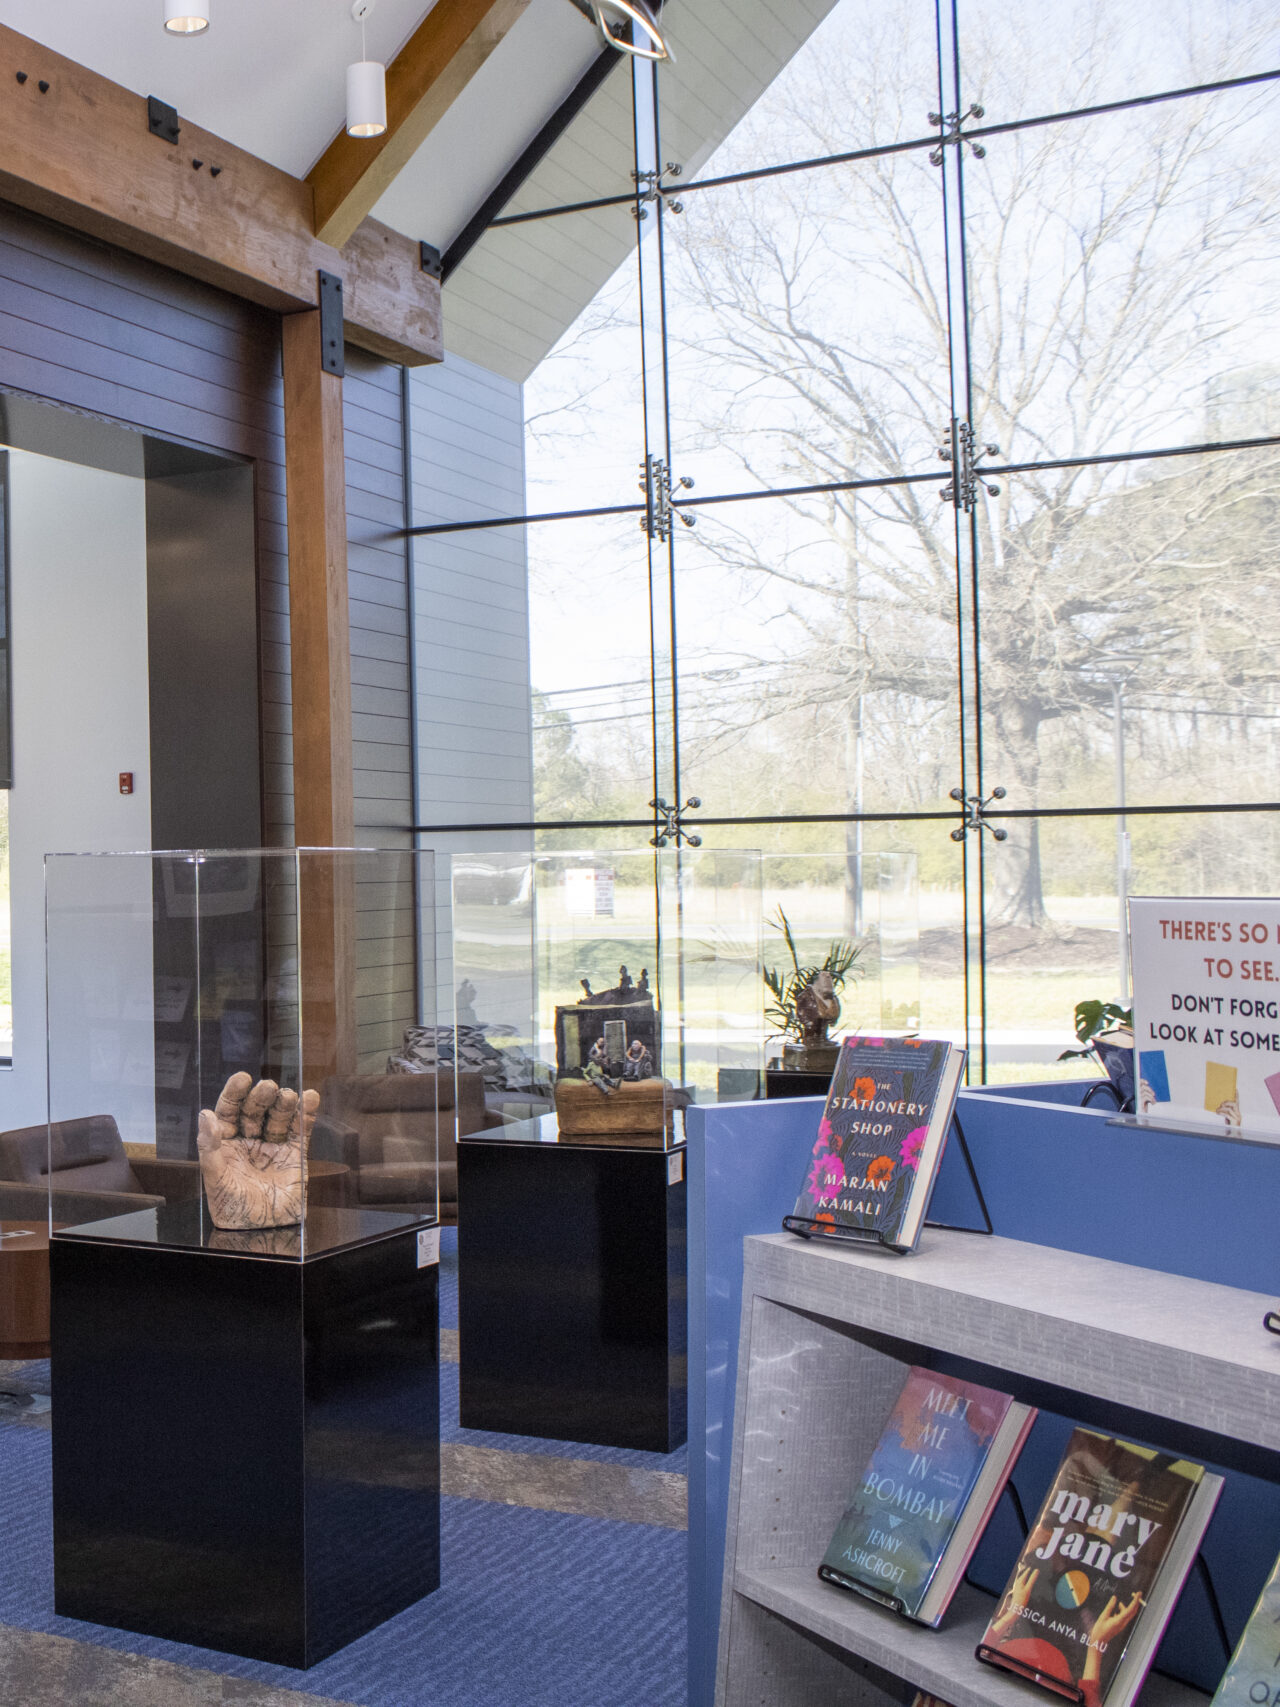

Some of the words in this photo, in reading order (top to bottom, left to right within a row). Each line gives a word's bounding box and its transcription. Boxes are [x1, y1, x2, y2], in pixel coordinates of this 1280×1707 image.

[1159, 920, 1232, 942] THERE'S
[1239, 923, 1269, 944] SO
[1203, 958, 1233, 979] TO
[1171, 993, 1224, 1015] DON'T
[1150, 1022, 1198, 1044] LOOK
[1203, 1028, 1224, 1046] AT
[1230, 1030, 1280, 1052] SOME
[877, 1082, 892, 1090] THE
[831, 1097, 928, 1116] STATIONERY
[851, 1122, 893, 1136] SHOP
[823, 1173, 889, 1192] MARJAN
[818, 1196, 881, 1216] KAMALI
[922, 1387, 974, 1421] MEET
[918, 1422, 950, 1450] ME
[908, 1453, 933, 1481] IN
[863, 1472, 951, 1523] BOMBAY
[1050, 1489, 1163, 1556] mary
[865, 1528, 903, 1553] JENNY
[842, 1544, 907, 1583] ASHCROFT
[1007, 1602, 1046, 1626] JESSICA
[1048, 1622, 1077, 1640] ANYA
[1079, 1633, 1108, 1653] BLAU
